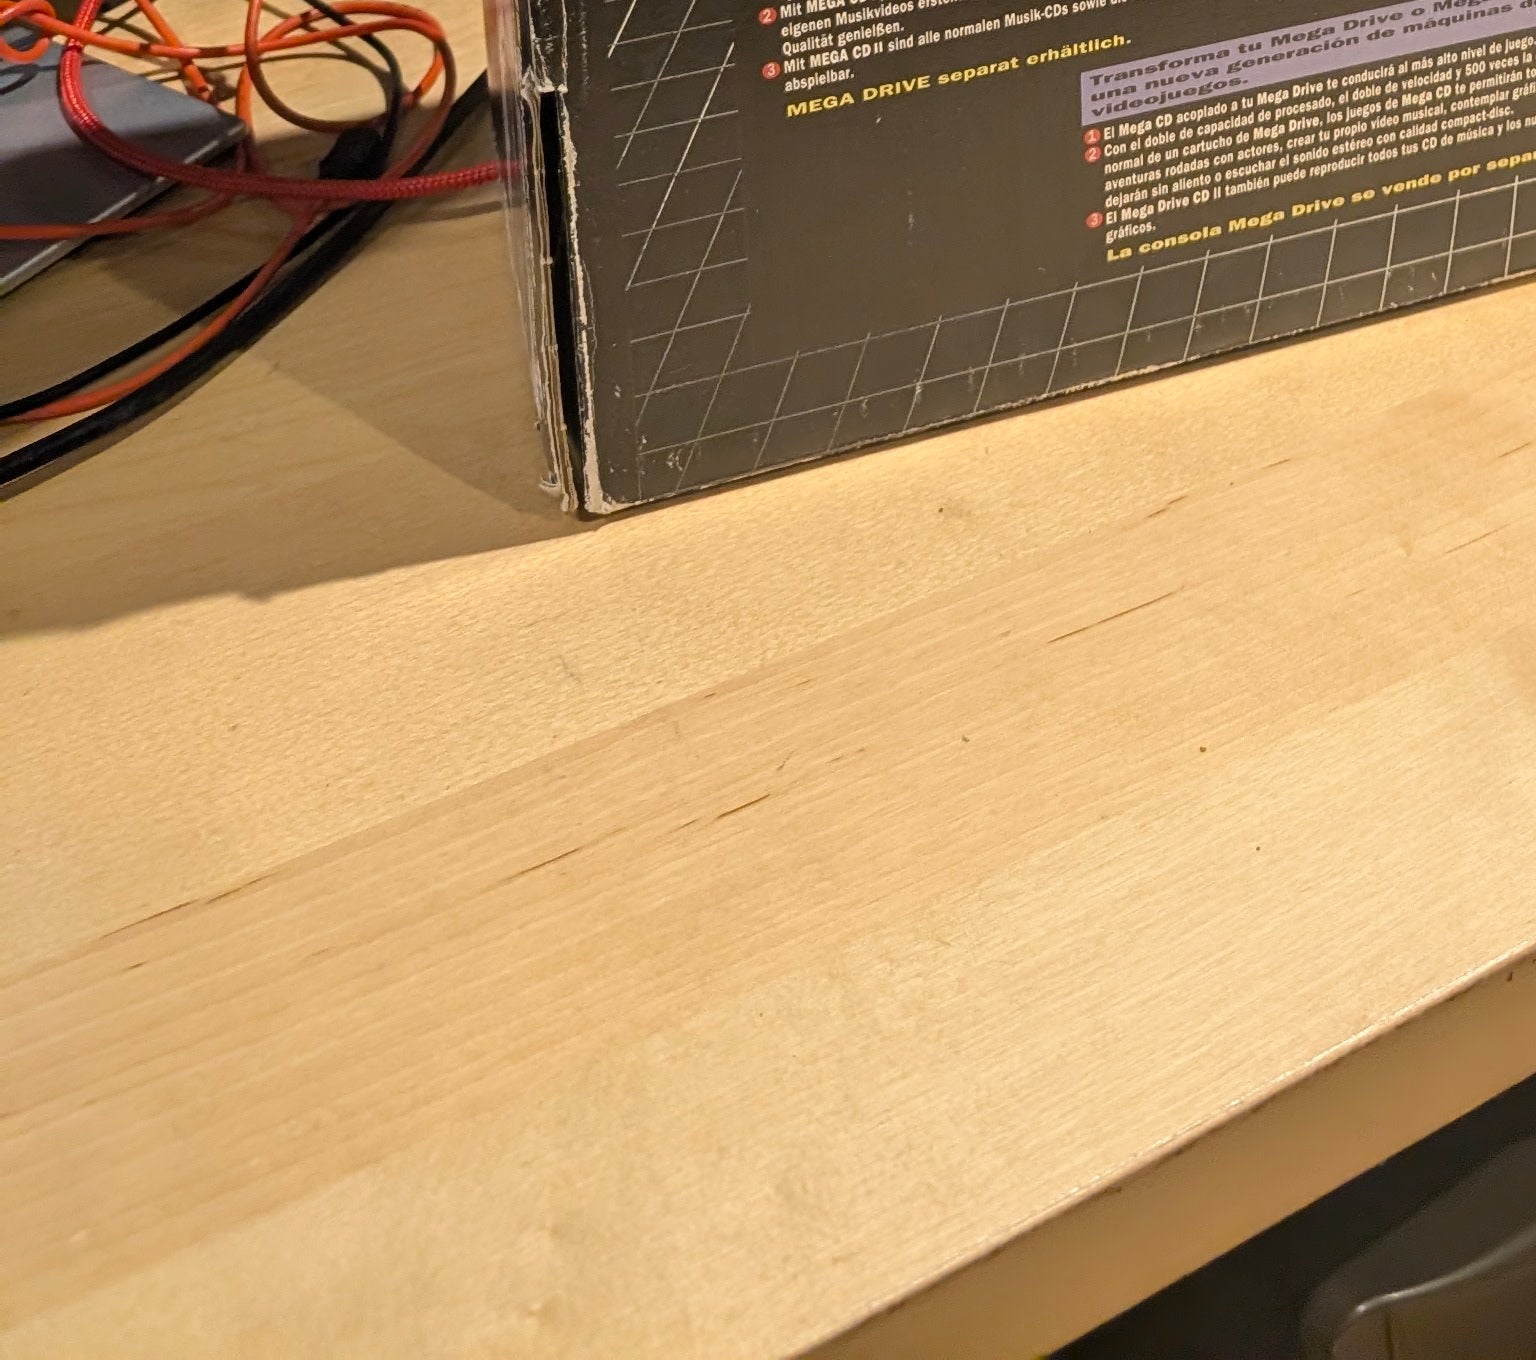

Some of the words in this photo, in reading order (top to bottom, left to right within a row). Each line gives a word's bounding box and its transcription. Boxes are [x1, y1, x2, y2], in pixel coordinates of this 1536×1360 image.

[1106, 247, 1132, 261] La
[1138, 225, 1222, 253] consola
[1228, 210, 1285, 232] Mega
[1291, 196, 1345, 217] Drive
[1351, 188, 1375, 202] se
[1381, 173, 1442, 195] vende
[1447, 163, 1480, 182] por
